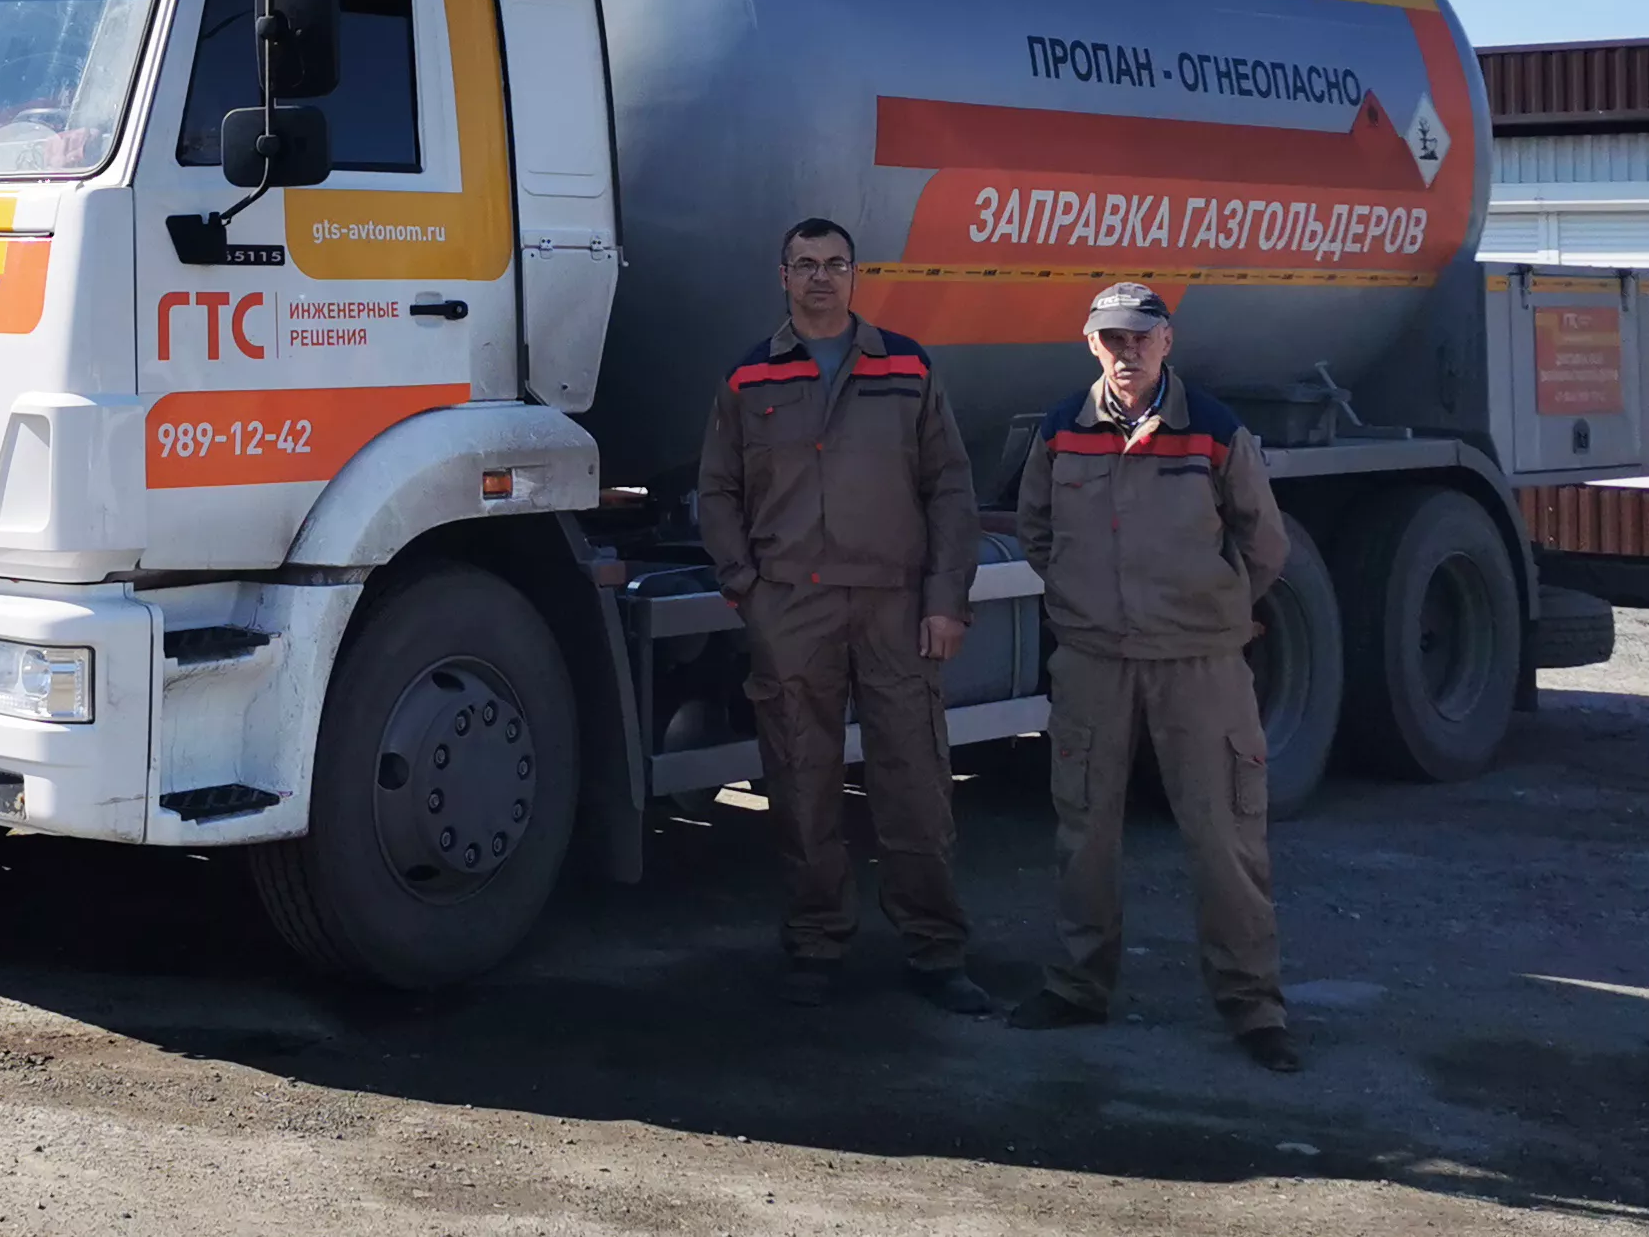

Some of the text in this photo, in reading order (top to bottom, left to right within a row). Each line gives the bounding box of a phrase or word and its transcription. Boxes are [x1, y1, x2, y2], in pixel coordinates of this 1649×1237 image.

[1027, 35, 1155, 87] ПРОПАН
[1178, 52, 1362, 107] ОГНЕОПАСНО
[312, 220, 446, 243] gts-avtonom.ru
[969, 187, 1427, 262] ЗАПРАВКА ГАЗГОЛЬДЕРОВ
[157, 291, 265, 360] ГТС
[289, 300, 400, 320] ИНЖЕНЕРНЫЕ
[289, 328, 367, 347] РЕШЕНИЯ
[157, 419, 312, 458] 989-12-42
